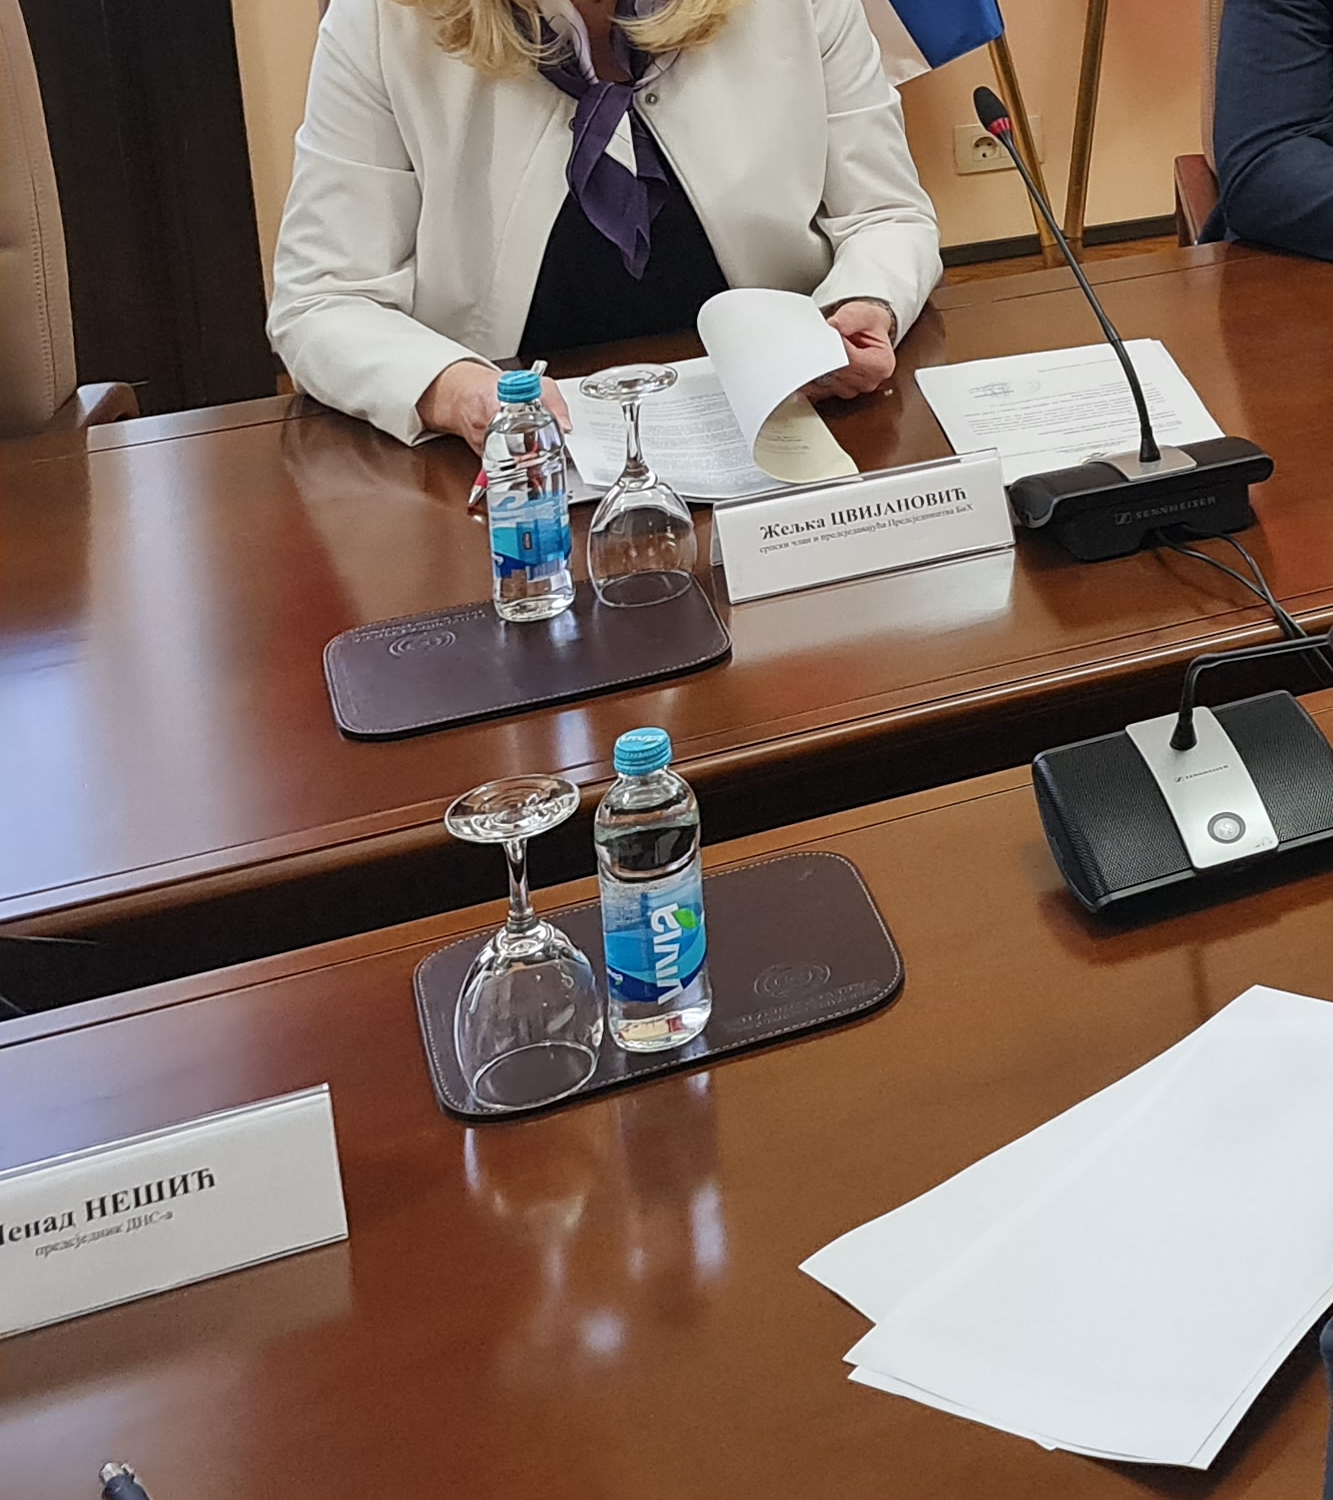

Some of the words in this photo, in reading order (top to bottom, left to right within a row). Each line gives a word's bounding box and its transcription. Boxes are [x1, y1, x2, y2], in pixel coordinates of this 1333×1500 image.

[759, 516, 826, 541] Жељка
[830, 486, 967, 527] ЦВИЈАНОВИЋ
[85, 1166, 216, 1223] НЕШИЋ
